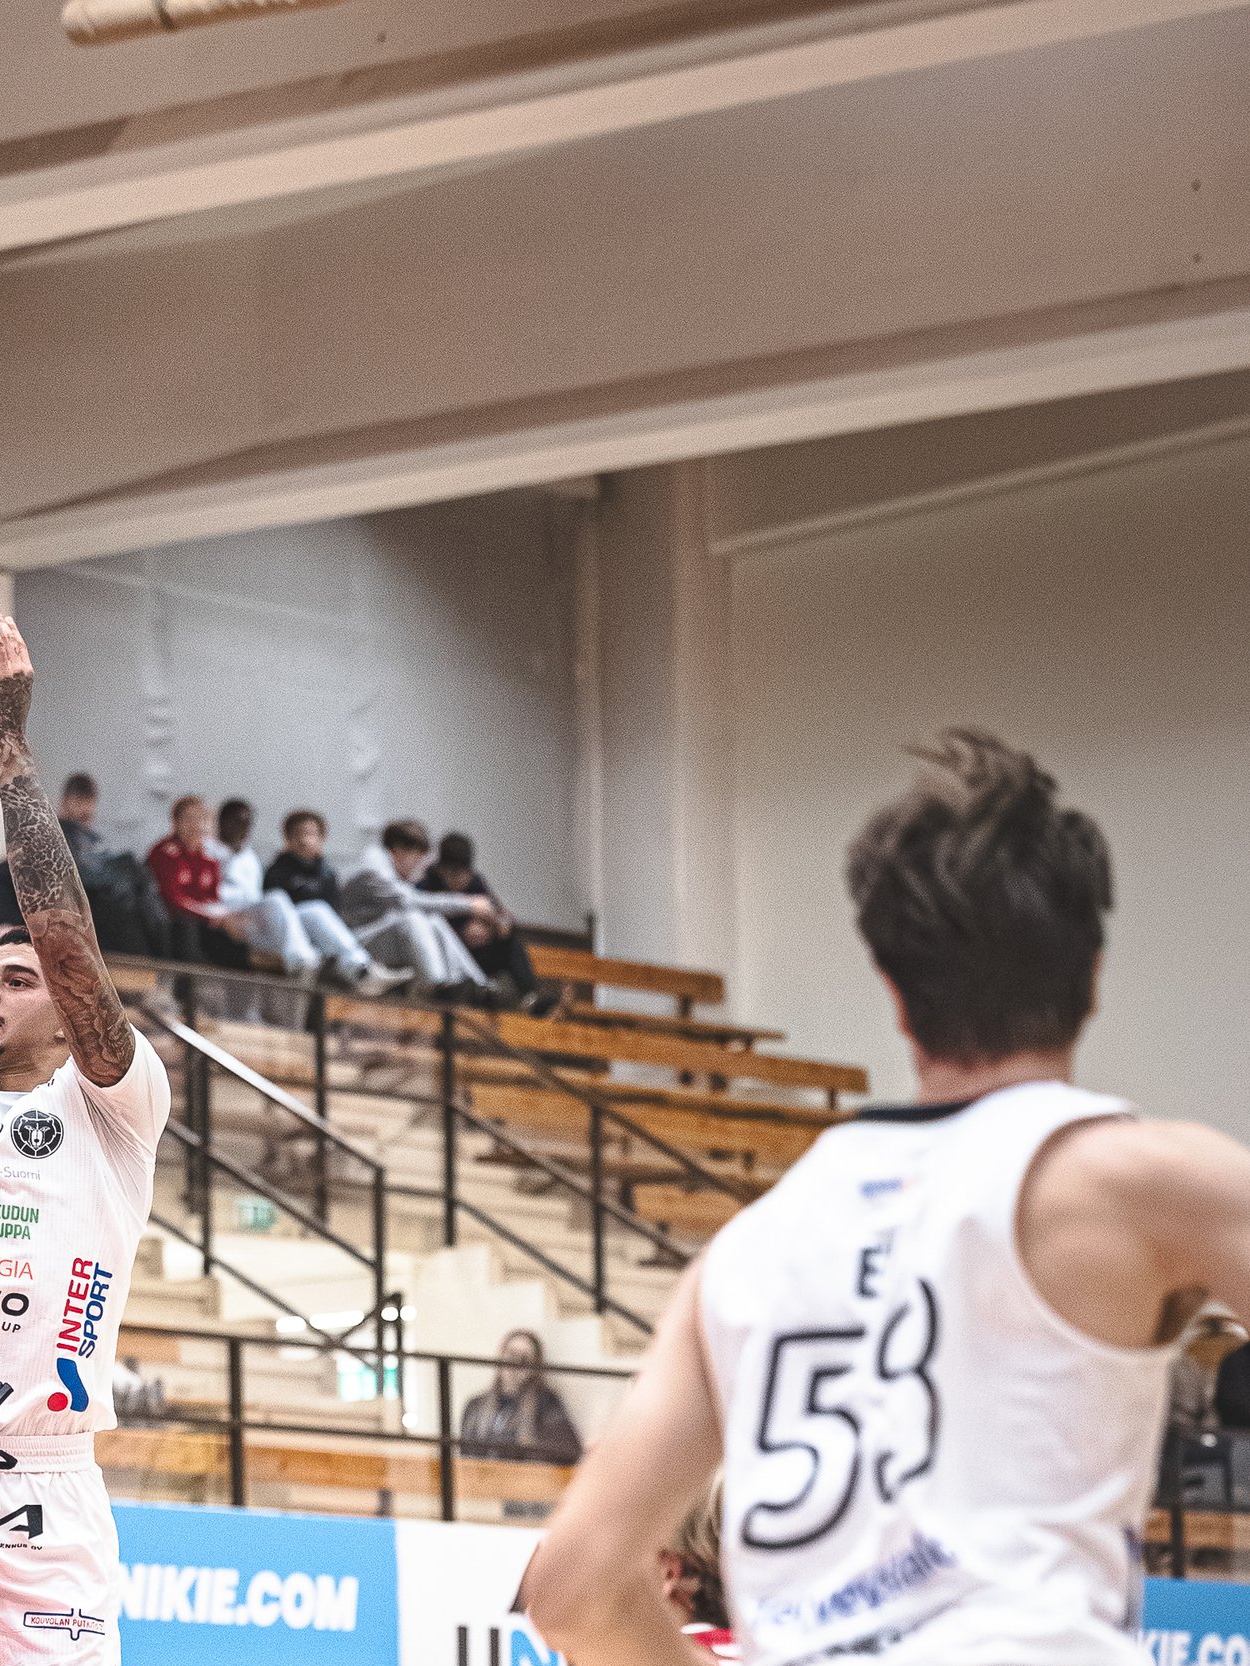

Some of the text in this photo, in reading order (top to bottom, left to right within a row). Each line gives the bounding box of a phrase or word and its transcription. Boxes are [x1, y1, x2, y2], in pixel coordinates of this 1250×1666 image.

[56, 1257, 93, 1352] INTER
[78, 1262, 113, 1358] SPORT
[30, 1616, 70, 1627] KOUVOLAN
[119, 1562, 360, 1632] NIKIE.COM
